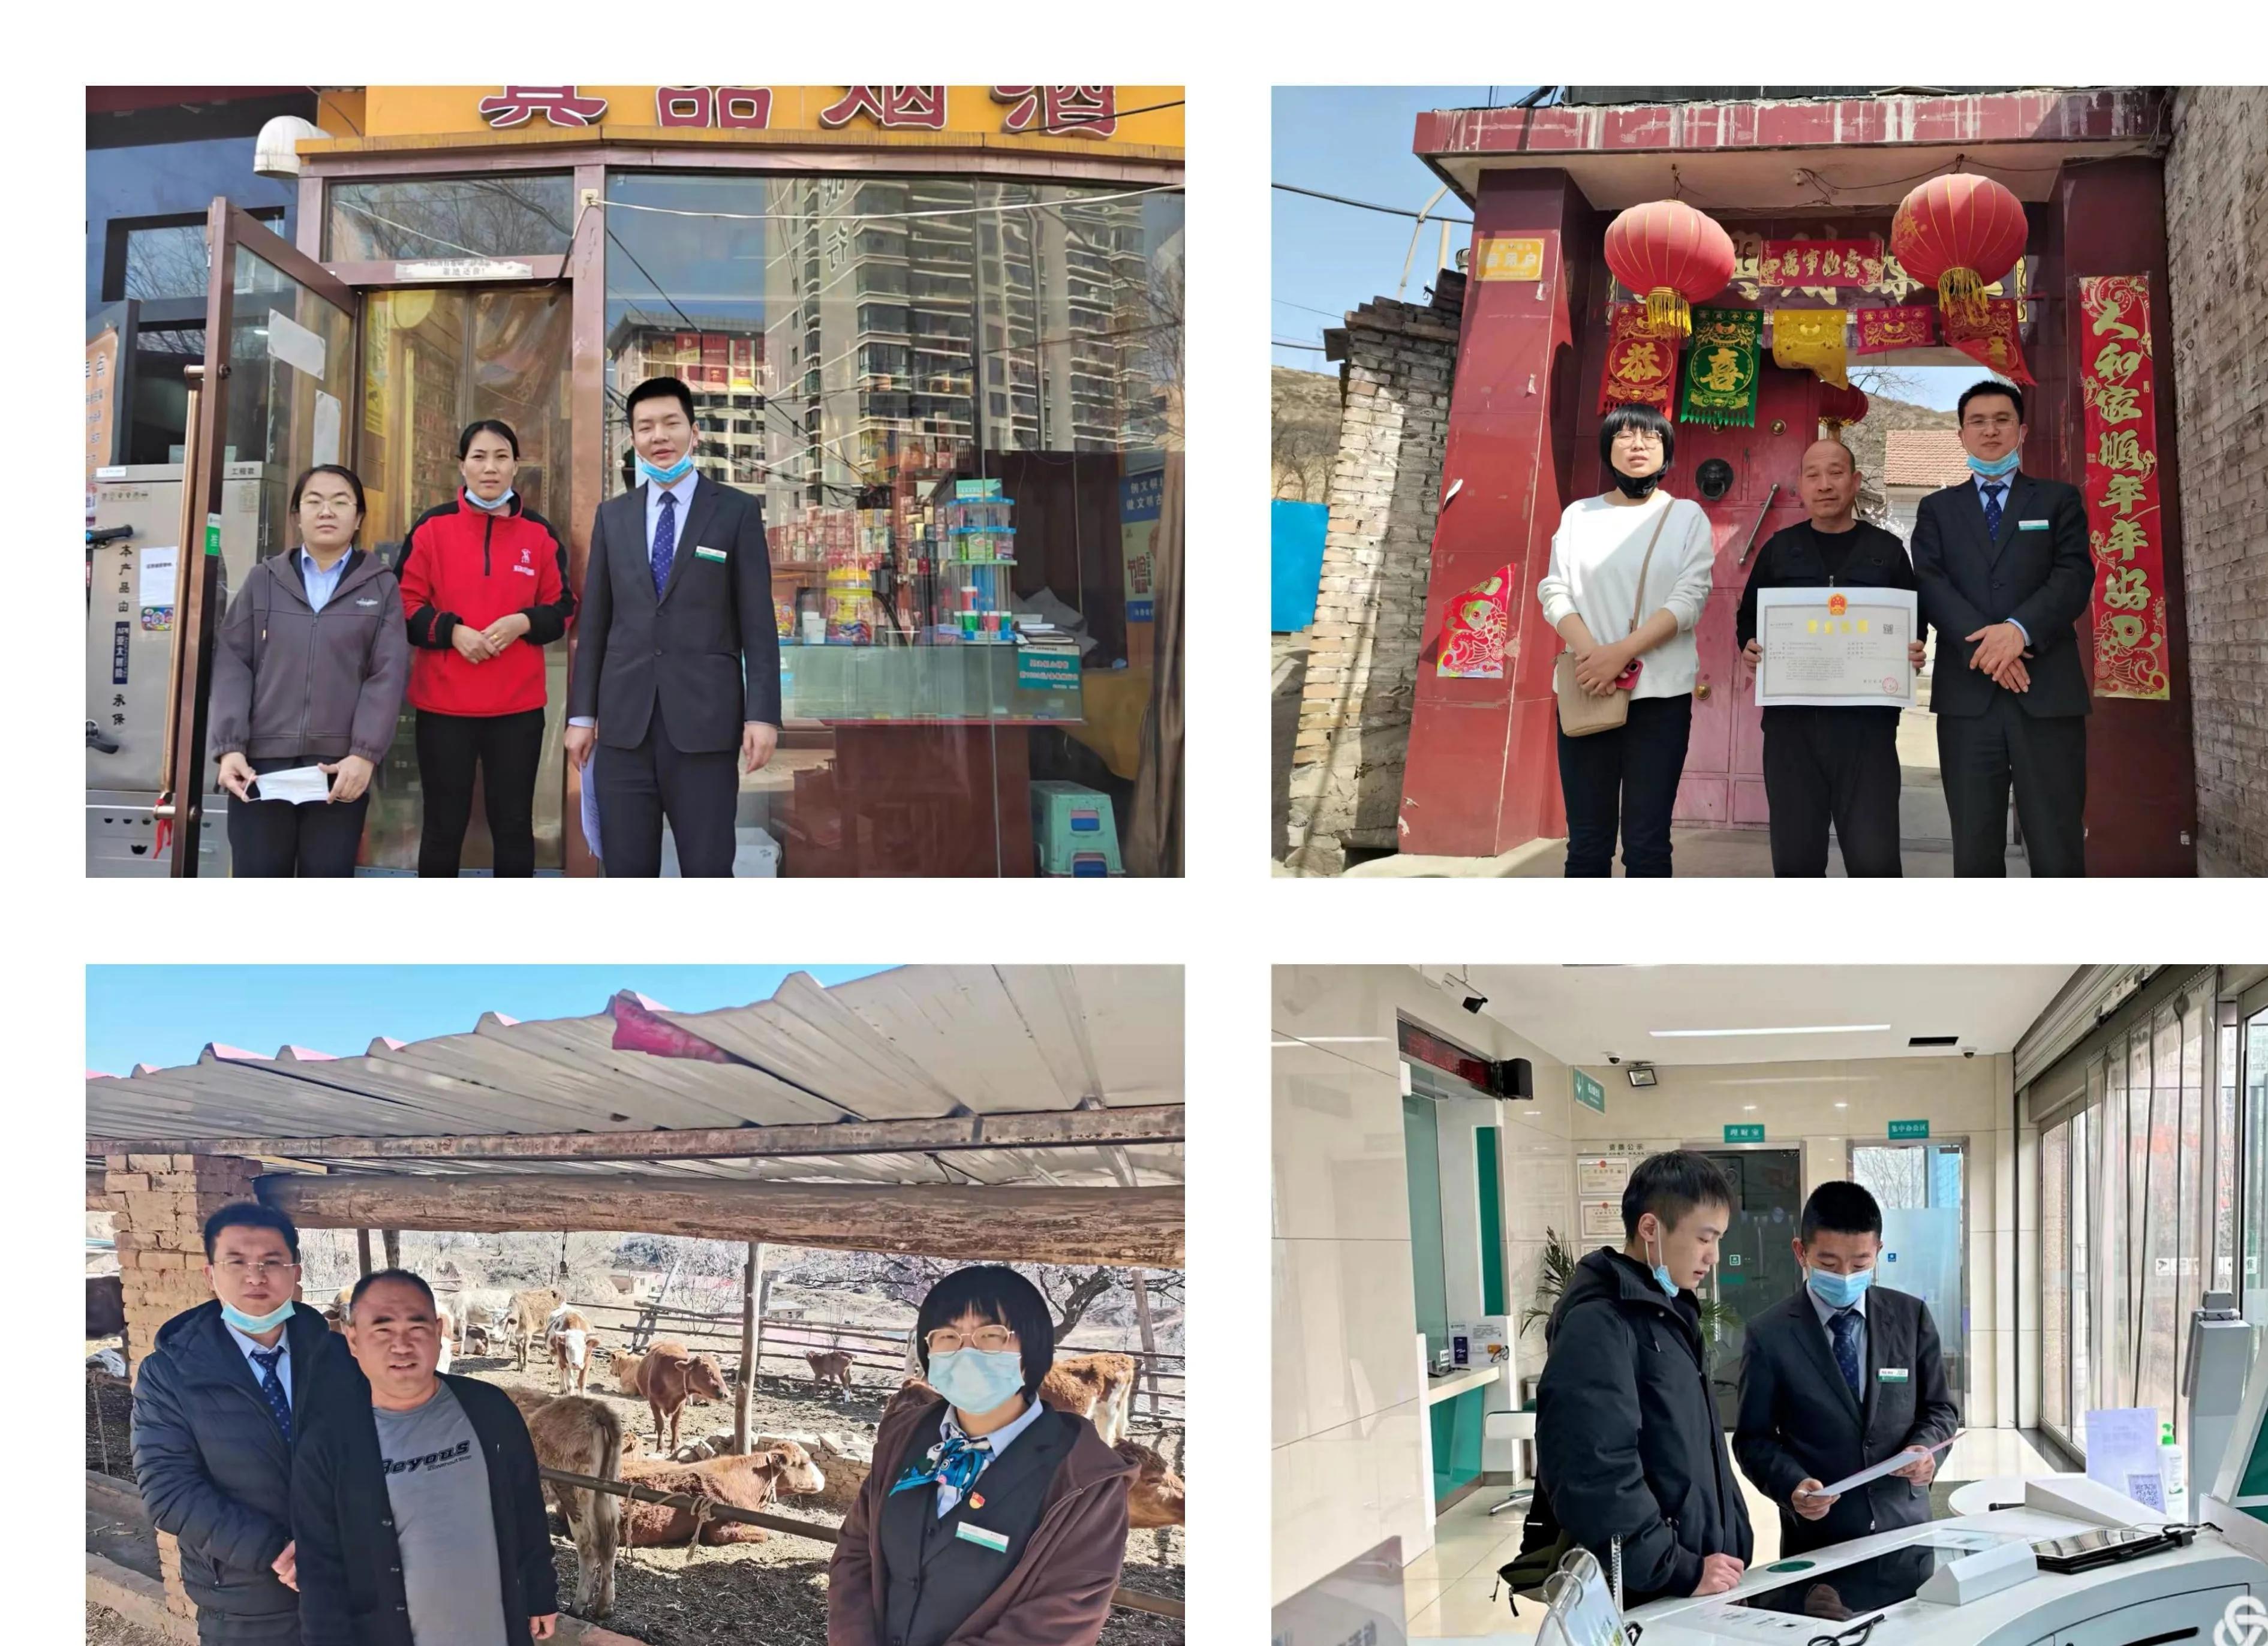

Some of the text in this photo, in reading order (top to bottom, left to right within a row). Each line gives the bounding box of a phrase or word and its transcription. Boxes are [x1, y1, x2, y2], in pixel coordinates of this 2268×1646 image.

[1781, 248, 1860, 278] 萬事如意
[1700, 348, 1744, 391] 喜
[119, 544, 133, 612] 本产品由
[112, 694, 126, 726] 承保
